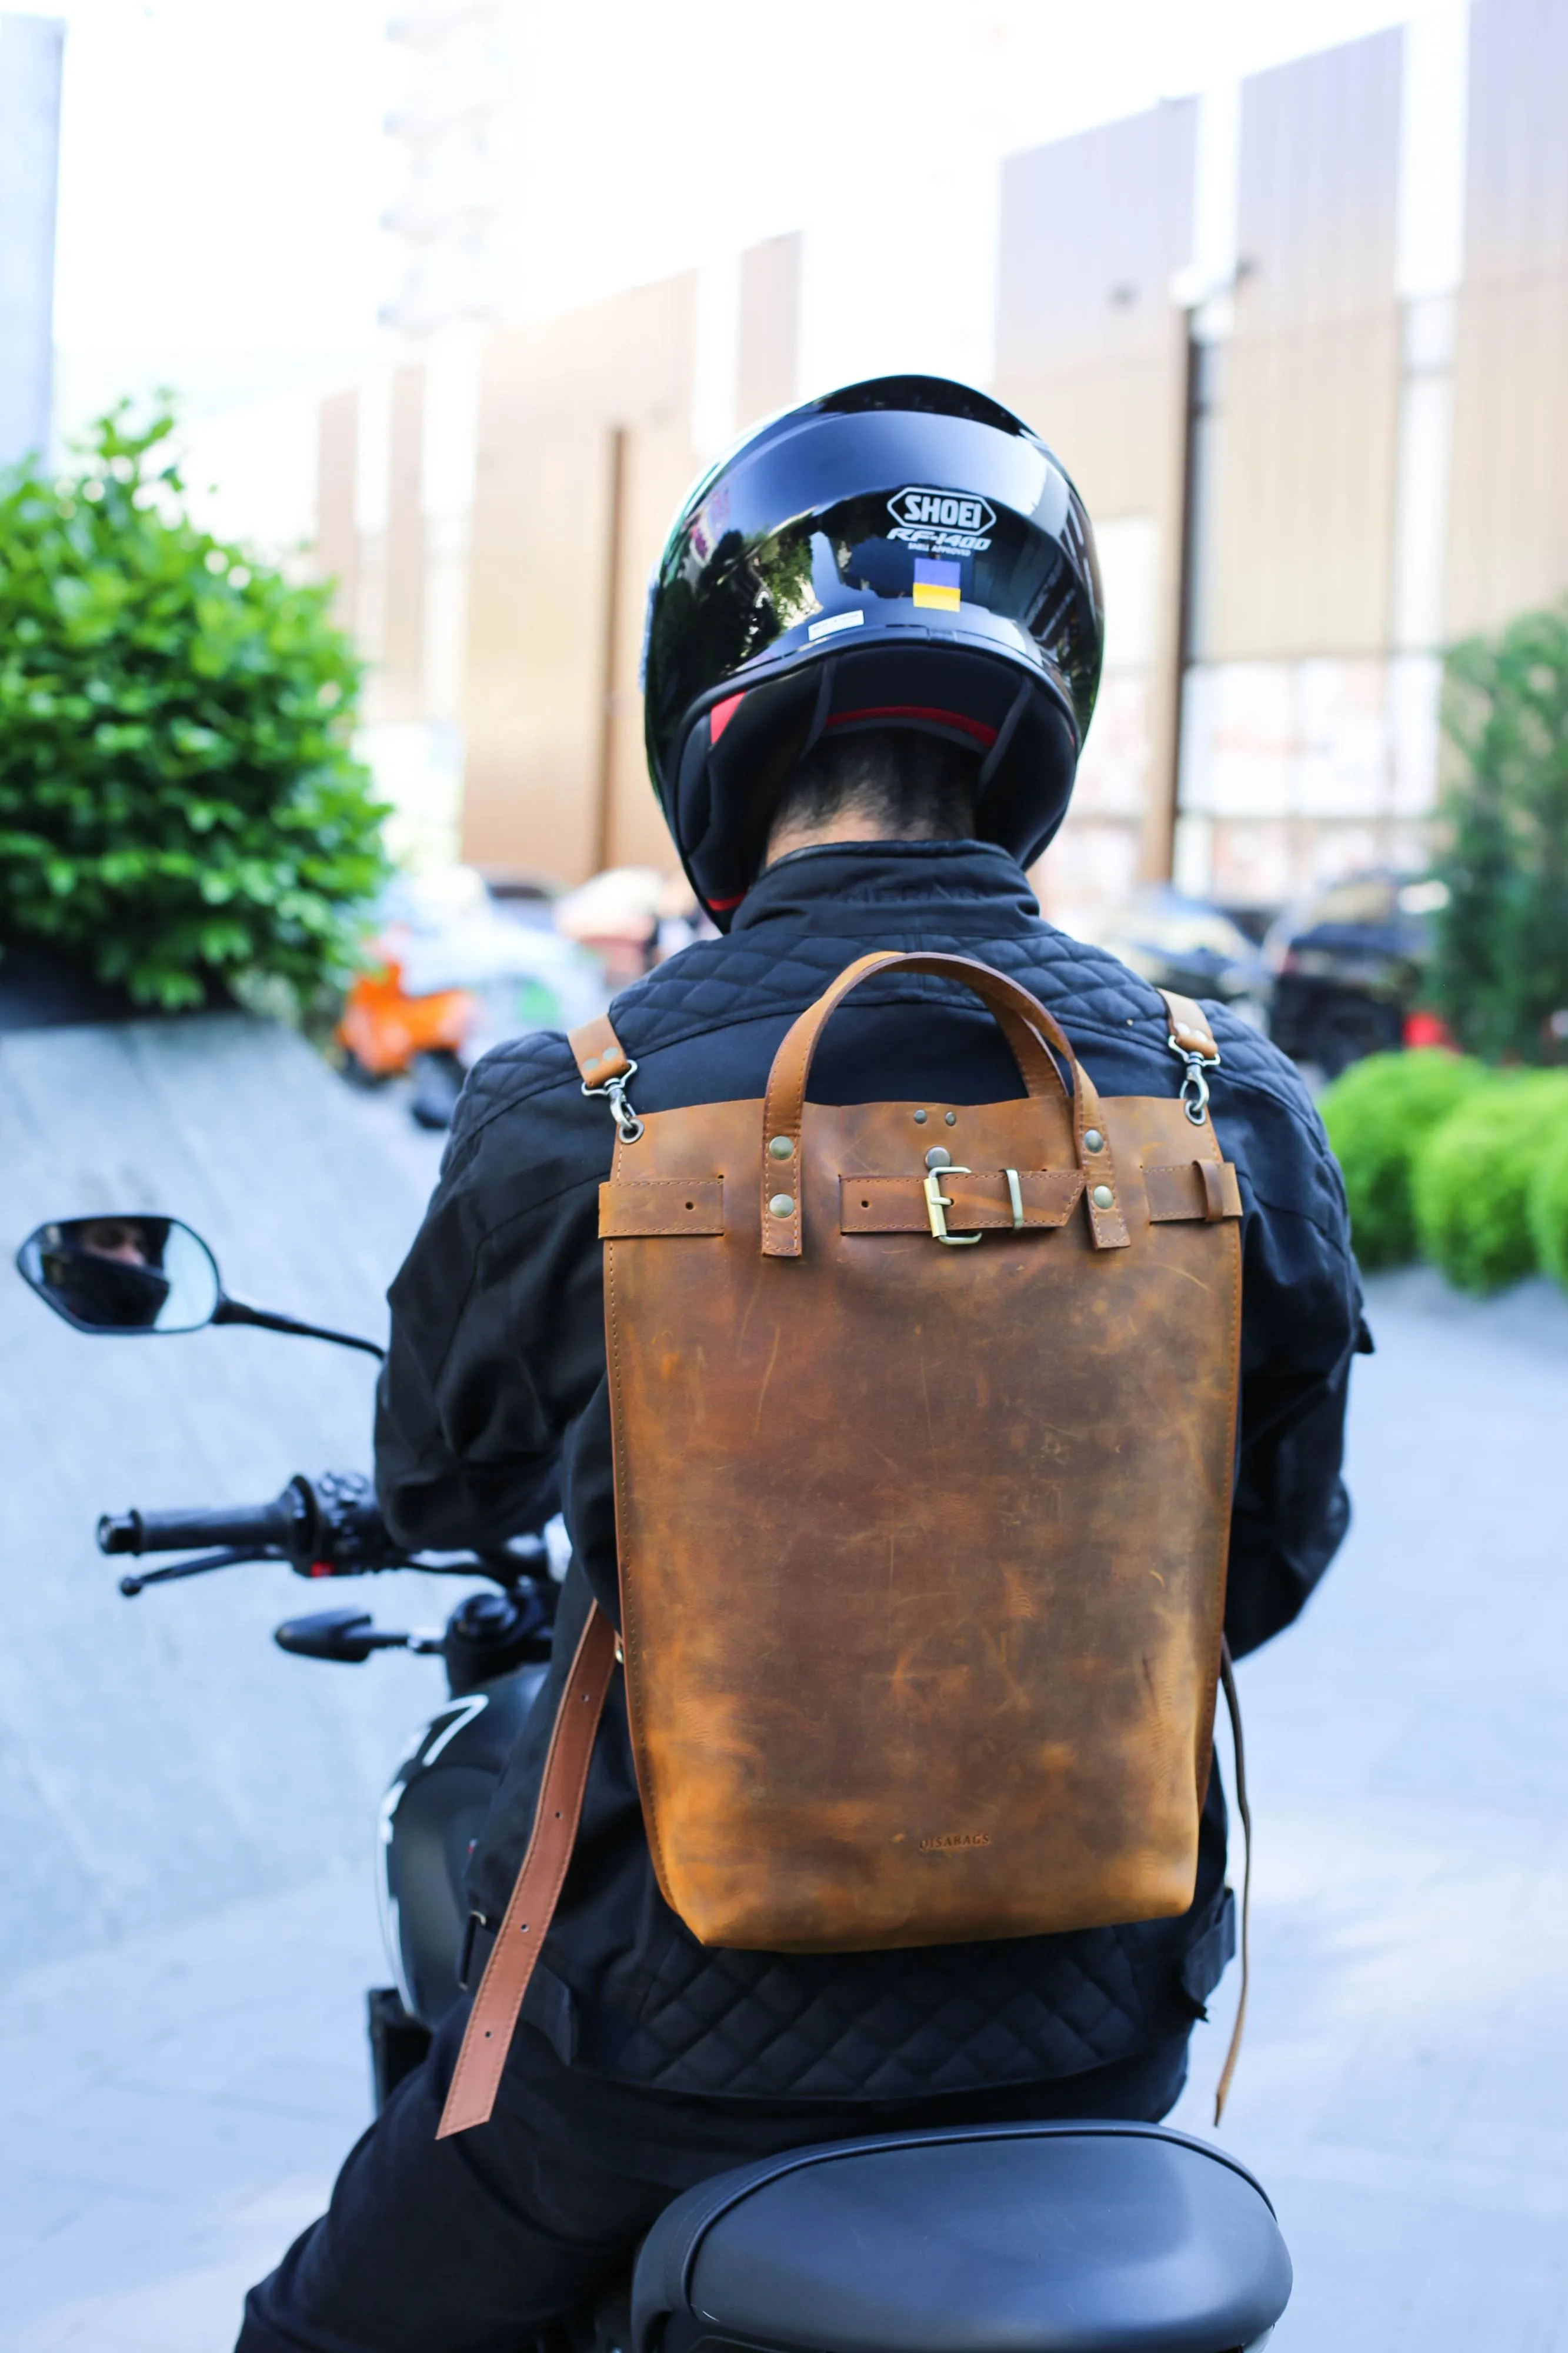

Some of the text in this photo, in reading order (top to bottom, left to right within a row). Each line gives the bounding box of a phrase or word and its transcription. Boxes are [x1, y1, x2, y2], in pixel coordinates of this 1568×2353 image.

[903, 495, 982, 529] SHOEI
[886, 527, 992, 551] RF-1400
[919, 1833, 990, 1851] QISABAGS
